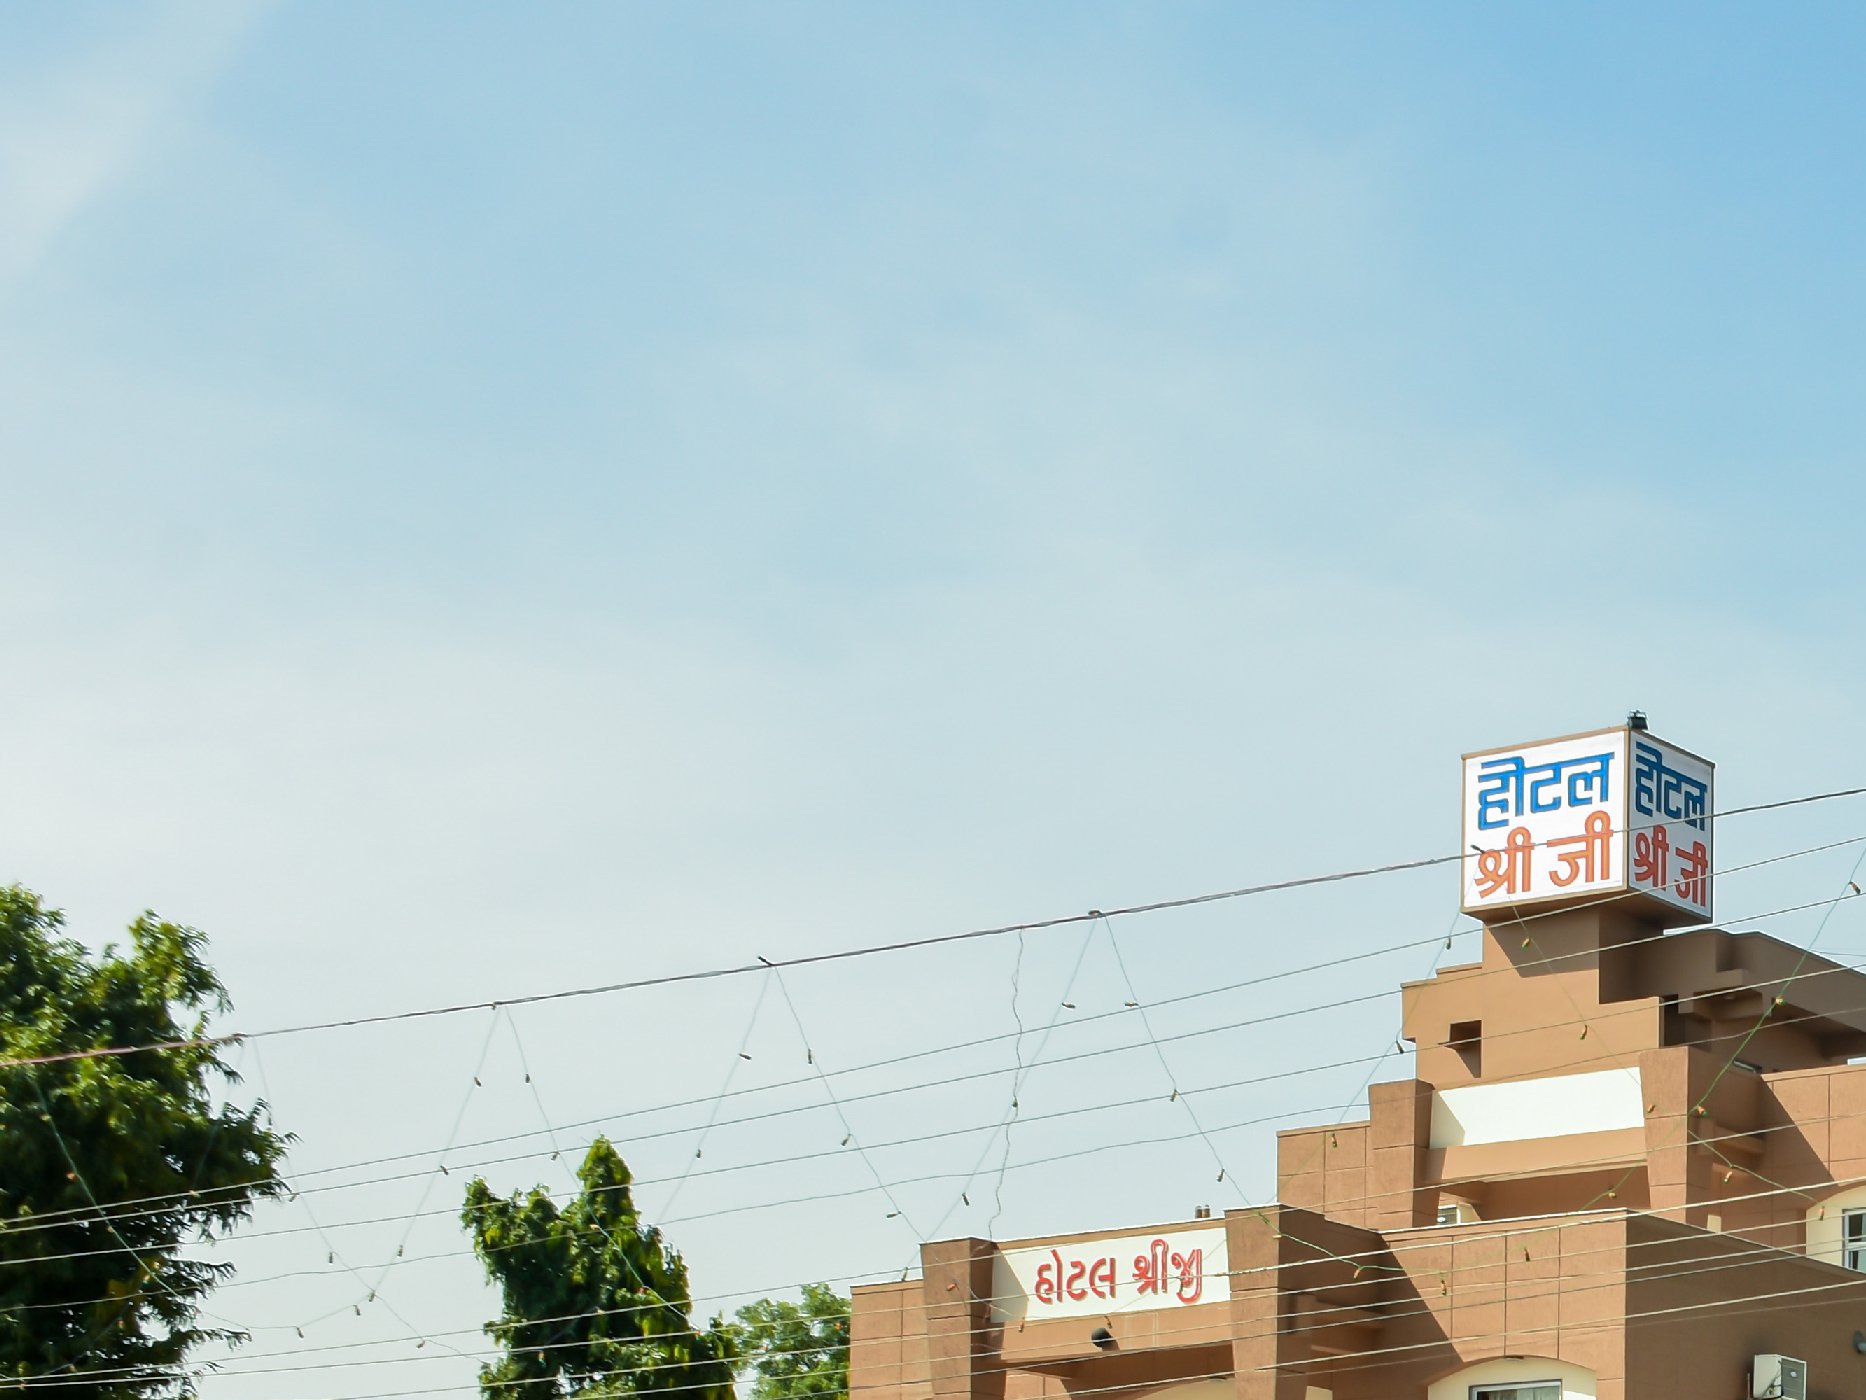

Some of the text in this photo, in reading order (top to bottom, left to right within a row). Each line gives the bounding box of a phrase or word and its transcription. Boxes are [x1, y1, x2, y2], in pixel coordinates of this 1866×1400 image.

[1478, 752, 1615, 831] होटल
[1635, 741, 1708, 831] होटल
[1475, 810, 1613, 899] श्री जी
[1634, 824, 1708, 908] श्री जी
[1035, 1248, 1116, 1304] હોટલ
